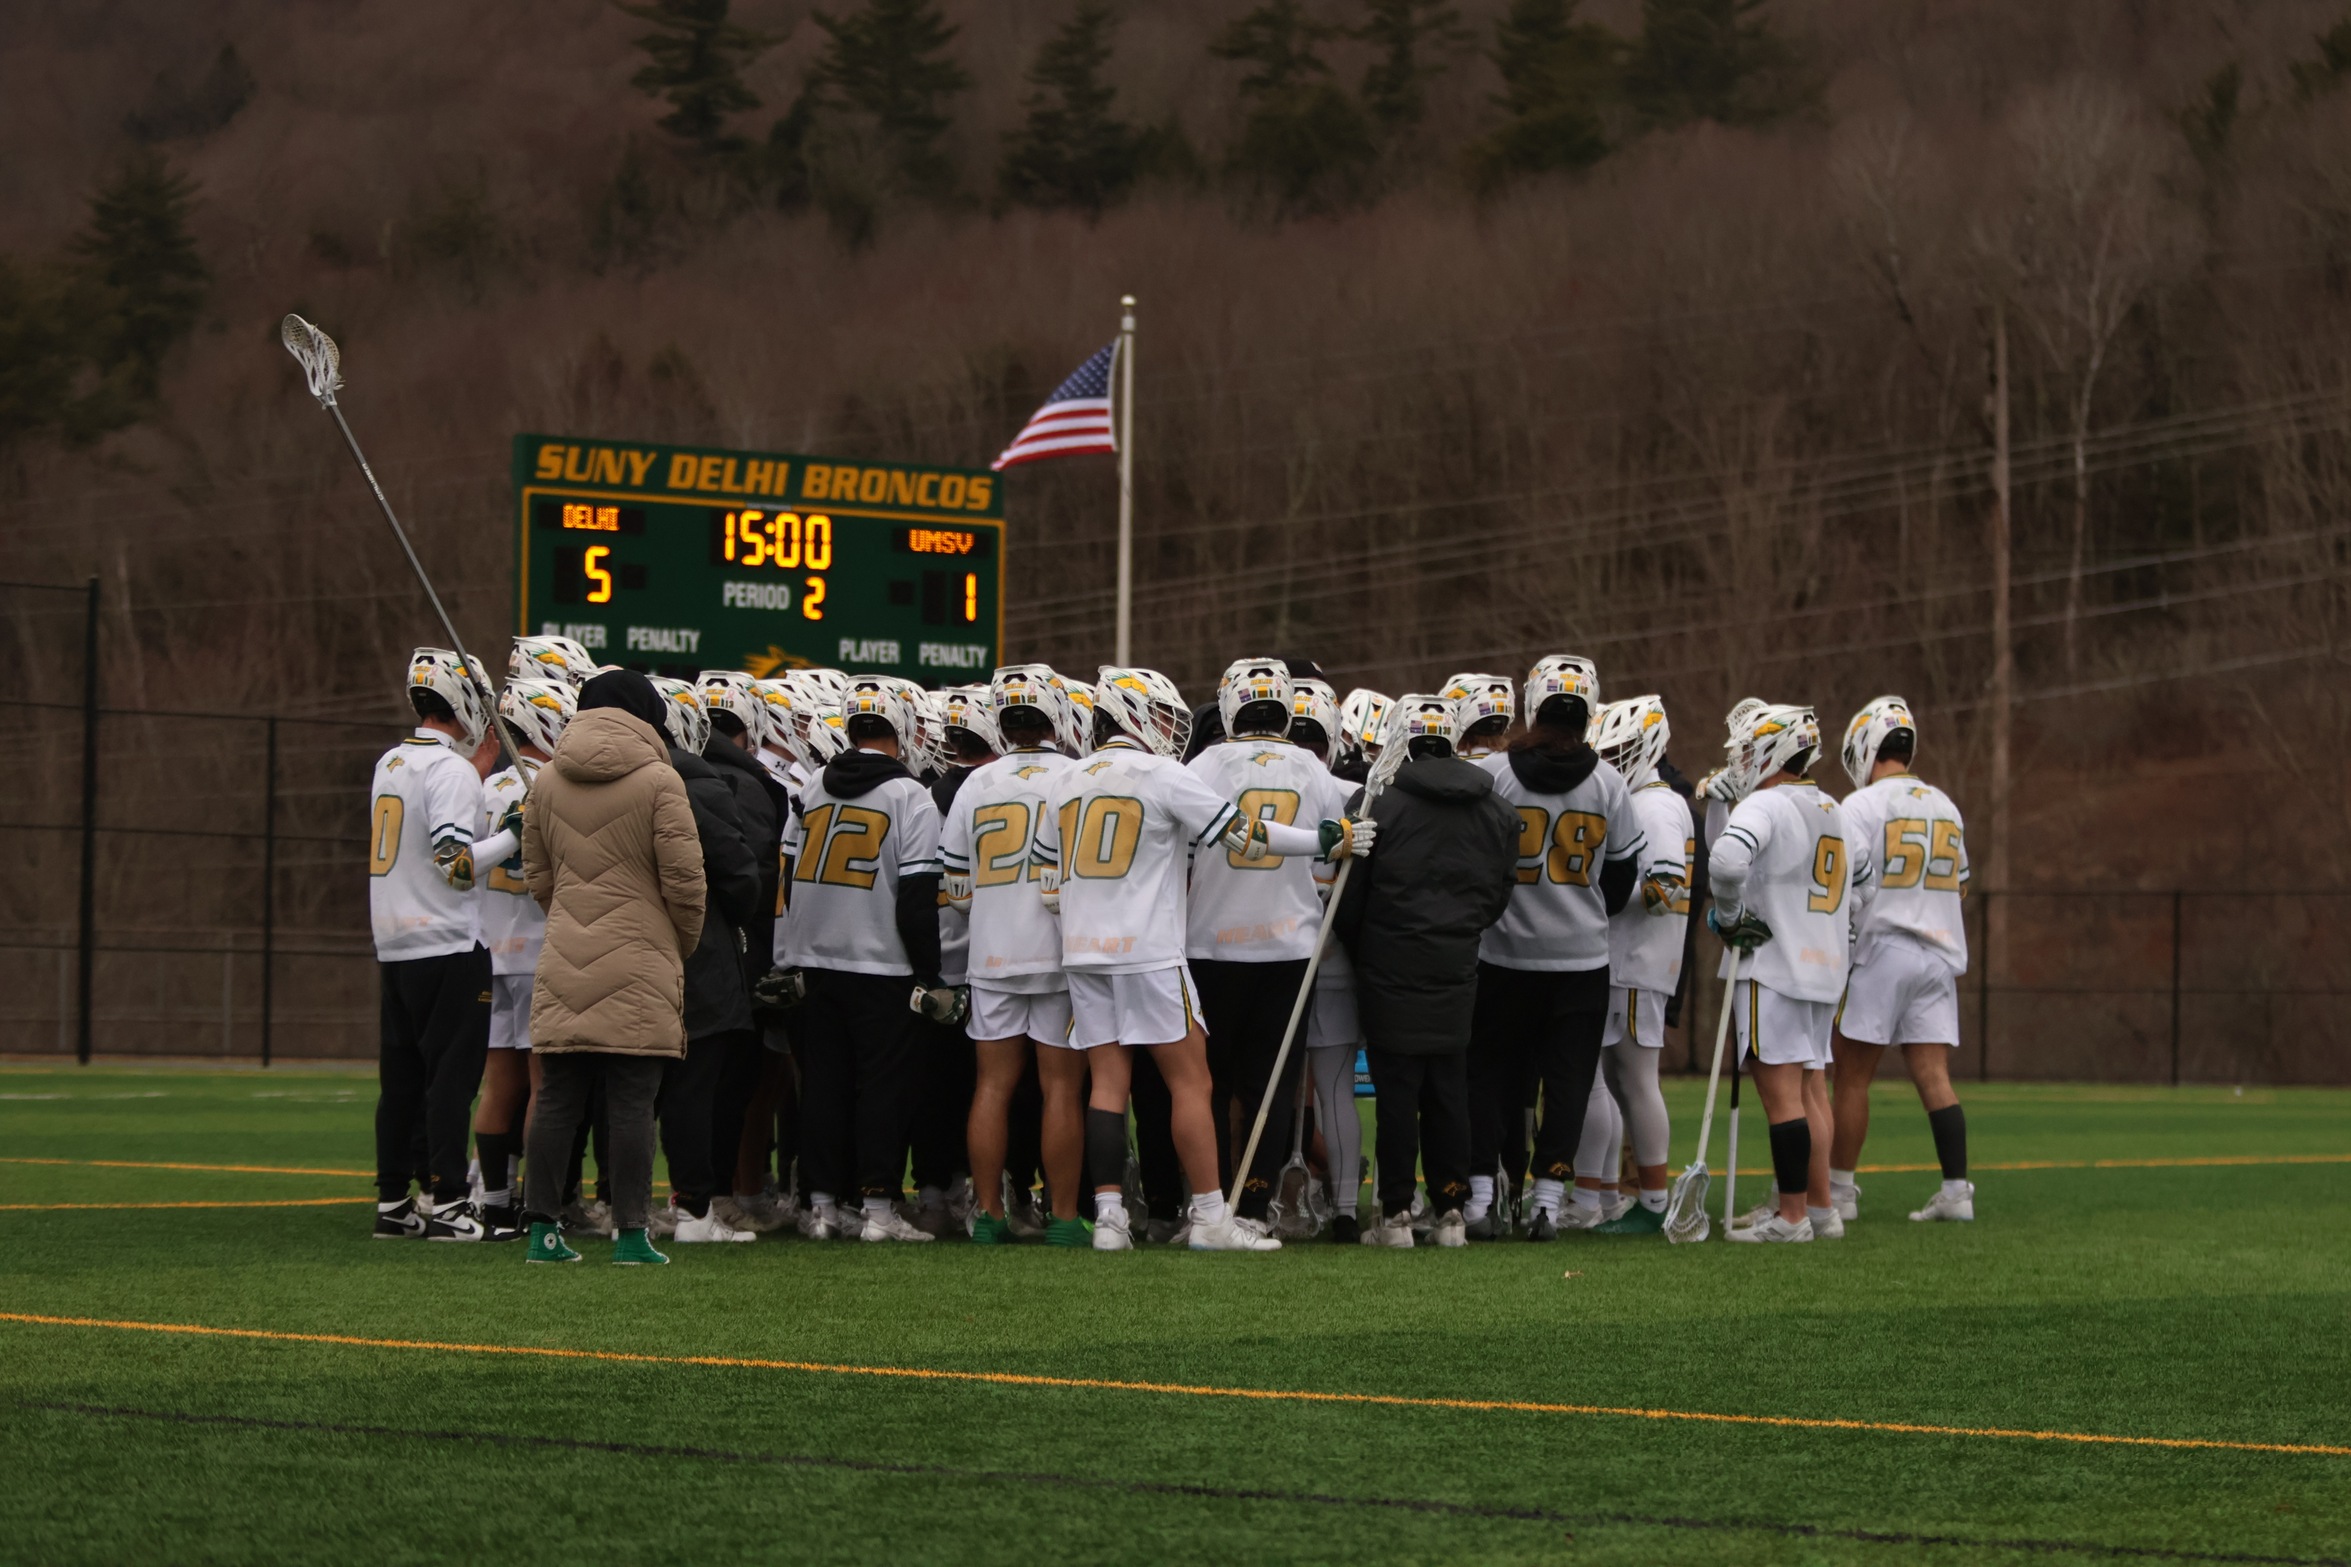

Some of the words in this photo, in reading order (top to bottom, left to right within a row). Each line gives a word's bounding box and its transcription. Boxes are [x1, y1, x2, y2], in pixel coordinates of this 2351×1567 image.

[535, 444, 657, 487] SUNY
[667, 453, 790, 497] DELHI
[802, 463, 993, 511] BRONCOS
[562, 503, 620, 532] DELHI
[724, 510, 832, 570] 15:00
[908, 529, 975, 555] UMSV
[584, 545, 612, 604] 5
[723, 580, 790, 610] PERIOD
[803, 576, 826, 621] 2
[965, 572, 977, 622] 1
[626, 626, 701, 653] PENALTY
[839, 637, 901, 664] PLAYER
[918, 641, 988, 668] PENALTY
[793, 803, 891, 891] 12
[1058, 796, 1145, 885] 10
[1515, 806, 1608, 888] 28
[1881, 818, 1962, 891] 55
[1807, 835, 1848, 916] 9
